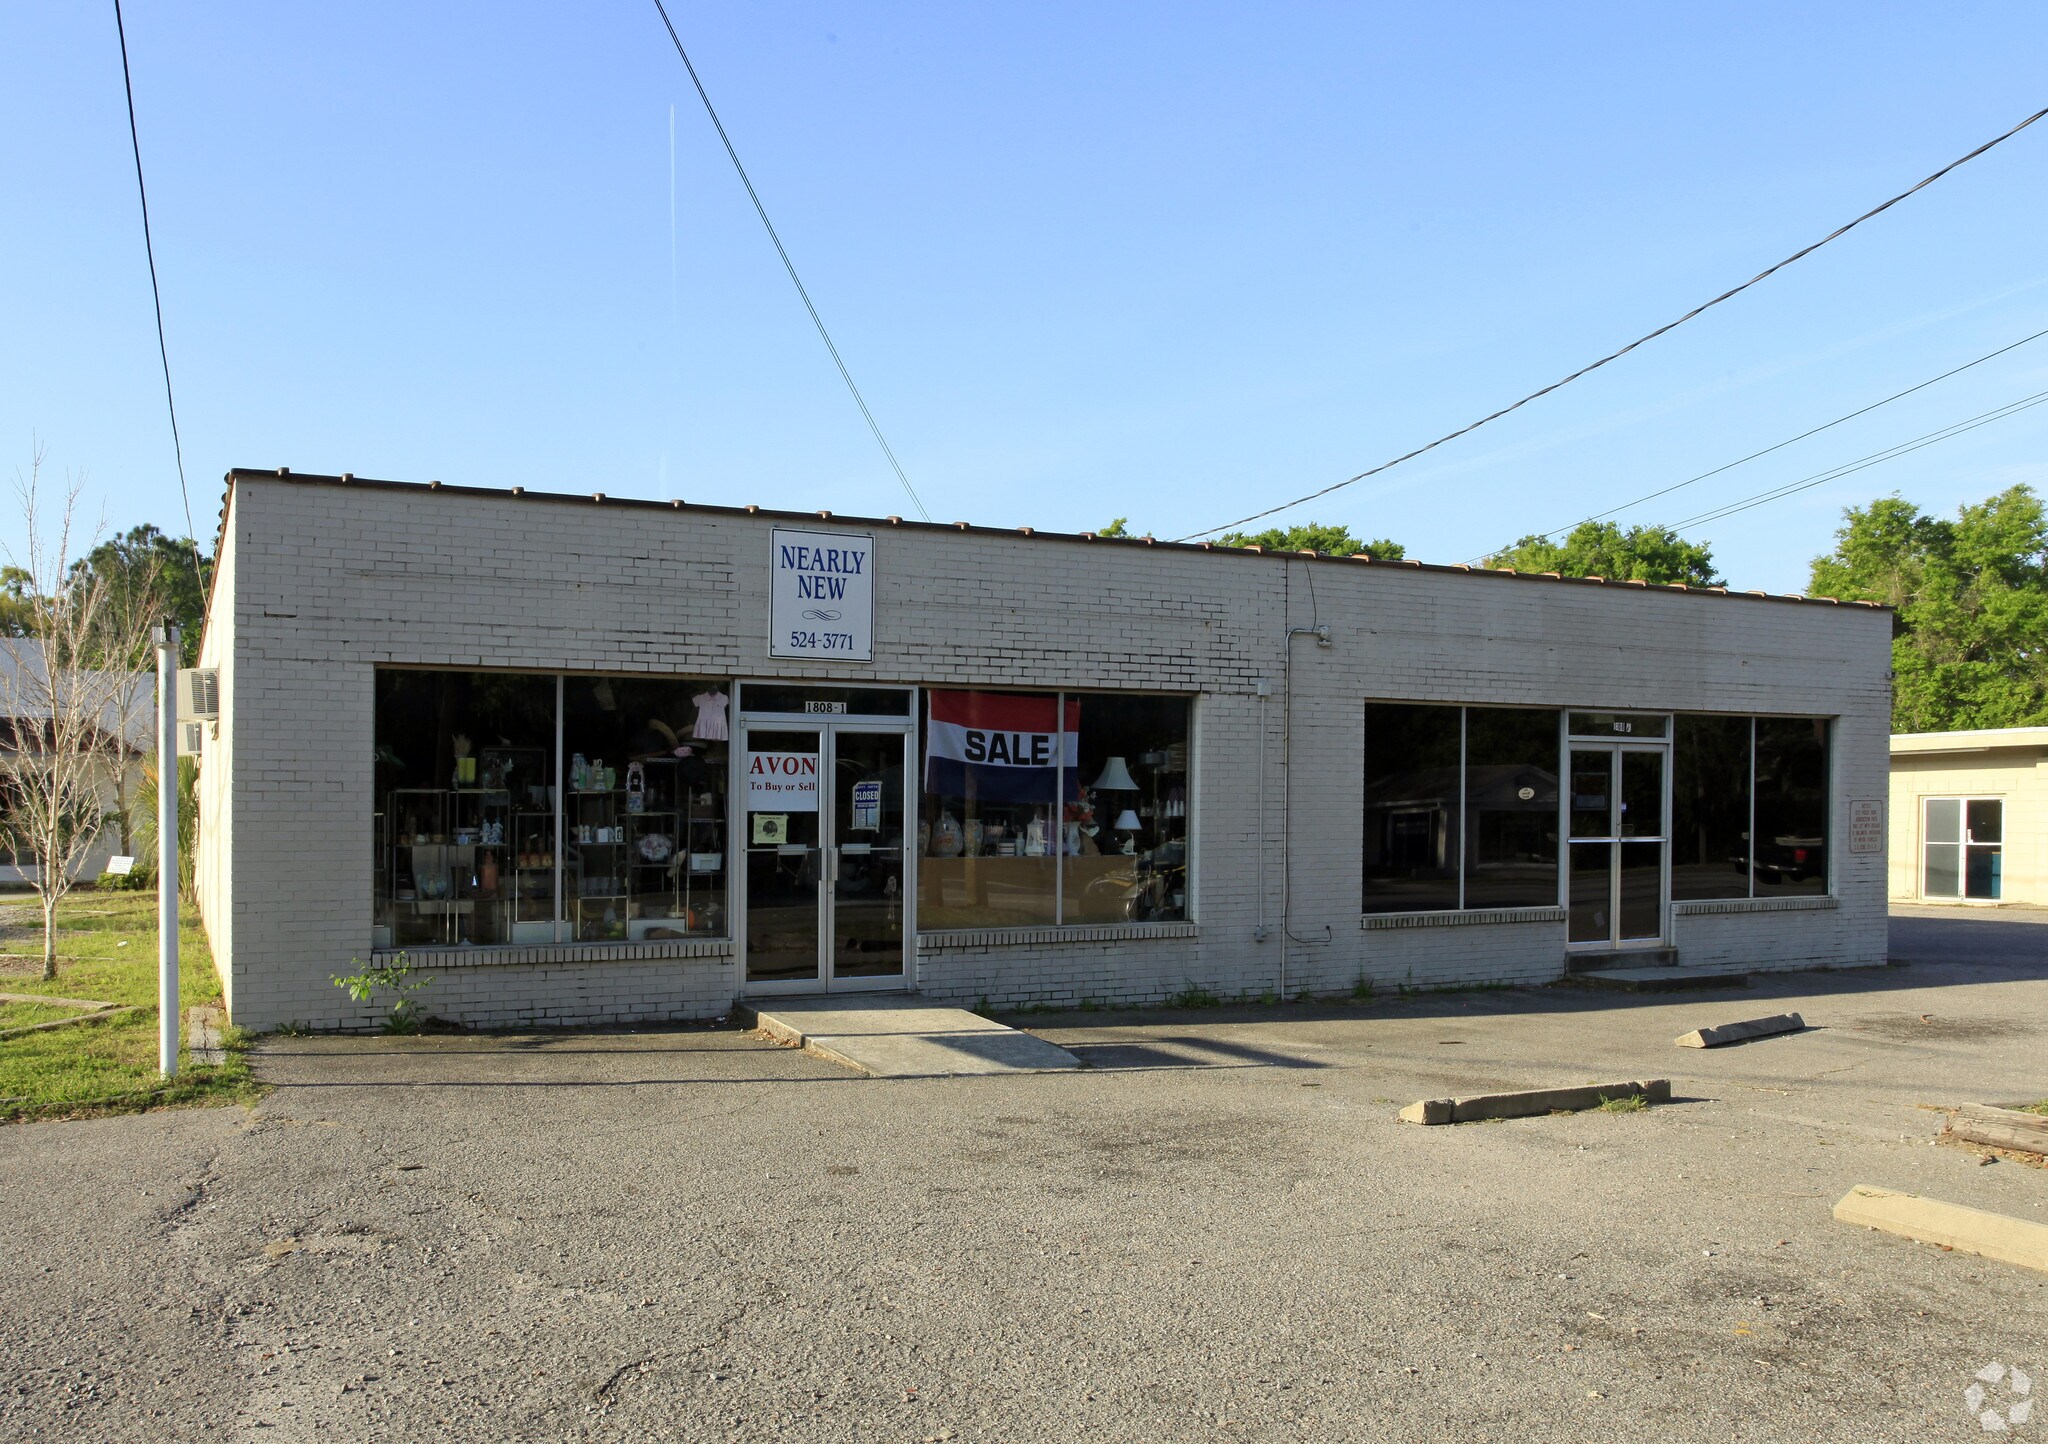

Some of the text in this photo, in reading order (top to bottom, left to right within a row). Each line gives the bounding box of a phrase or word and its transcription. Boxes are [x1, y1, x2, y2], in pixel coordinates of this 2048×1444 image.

[780, 545, 866, 574] NEARLY
[797, 574, 847, 600] NEW
[790, 631, 853, 650] 524-3771
[964, 730, 1050, 765] SALE
[749, 756, 817, 775] AVON
[750, 781, 762, 791] To
[765, 781, 782, 793] Buy
[798, 782, 815, 791] Sell
[855, 790, 879, 801] CLOSED
